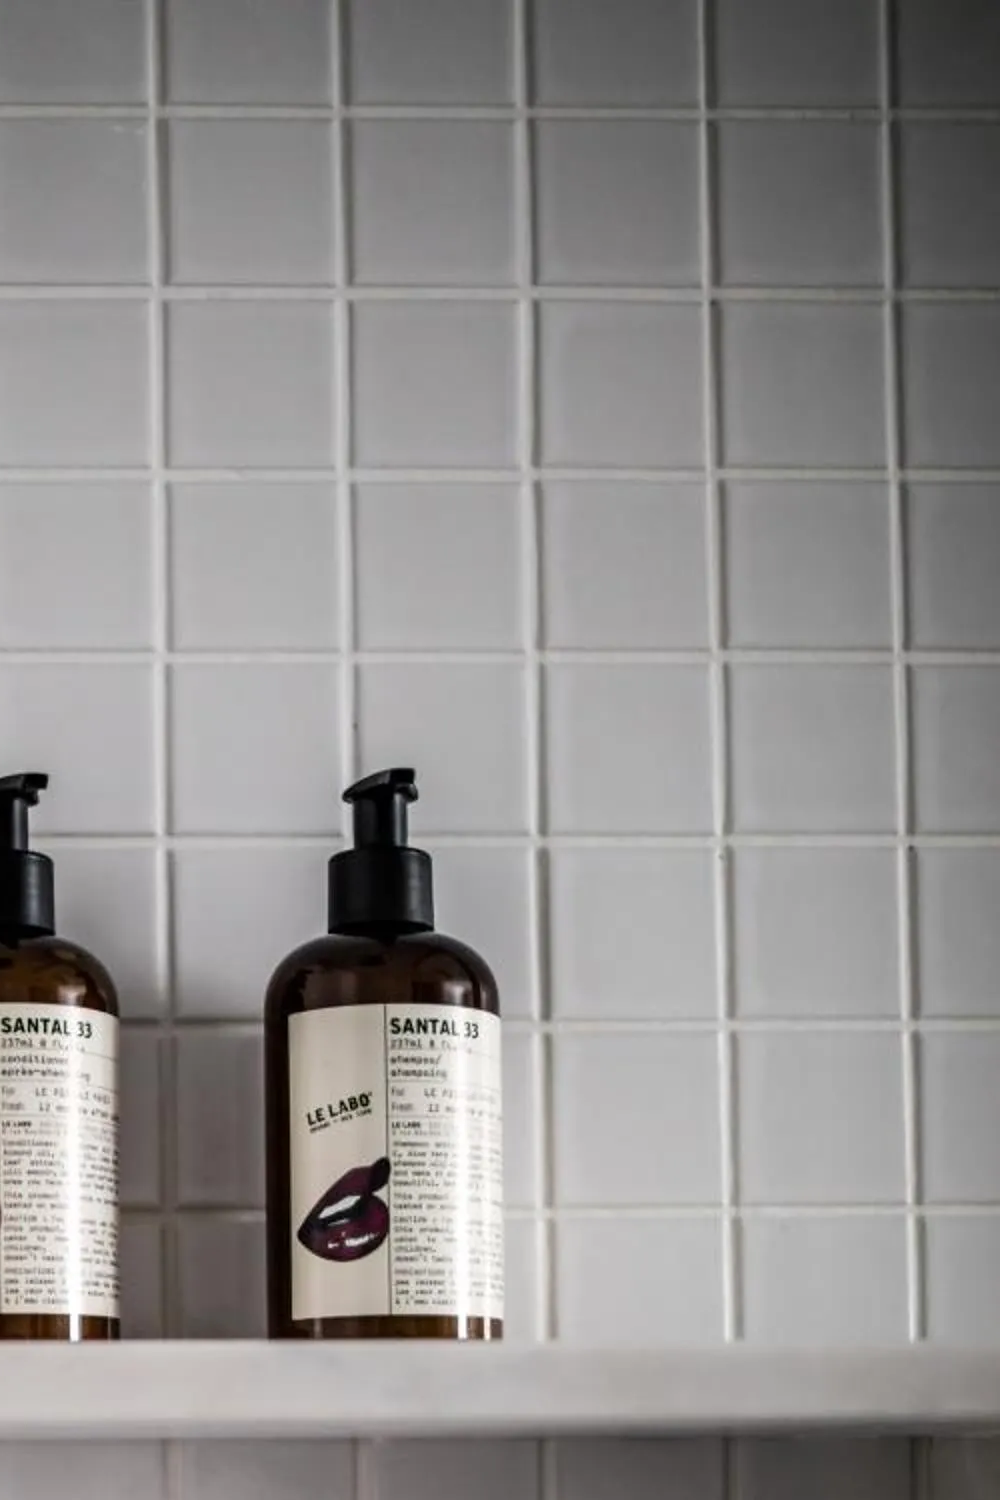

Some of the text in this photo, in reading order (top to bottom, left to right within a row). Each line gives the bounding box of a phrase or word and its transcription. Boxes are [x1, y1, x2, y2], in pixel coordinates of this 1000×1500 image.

[1, 1016, 92, 1040] SANTAL 33
[390, 1016, 480, 1040] SANTAL 33
[307, 1107, 325, 1126] LE
[327, 1091, 373, 1117] LABO
